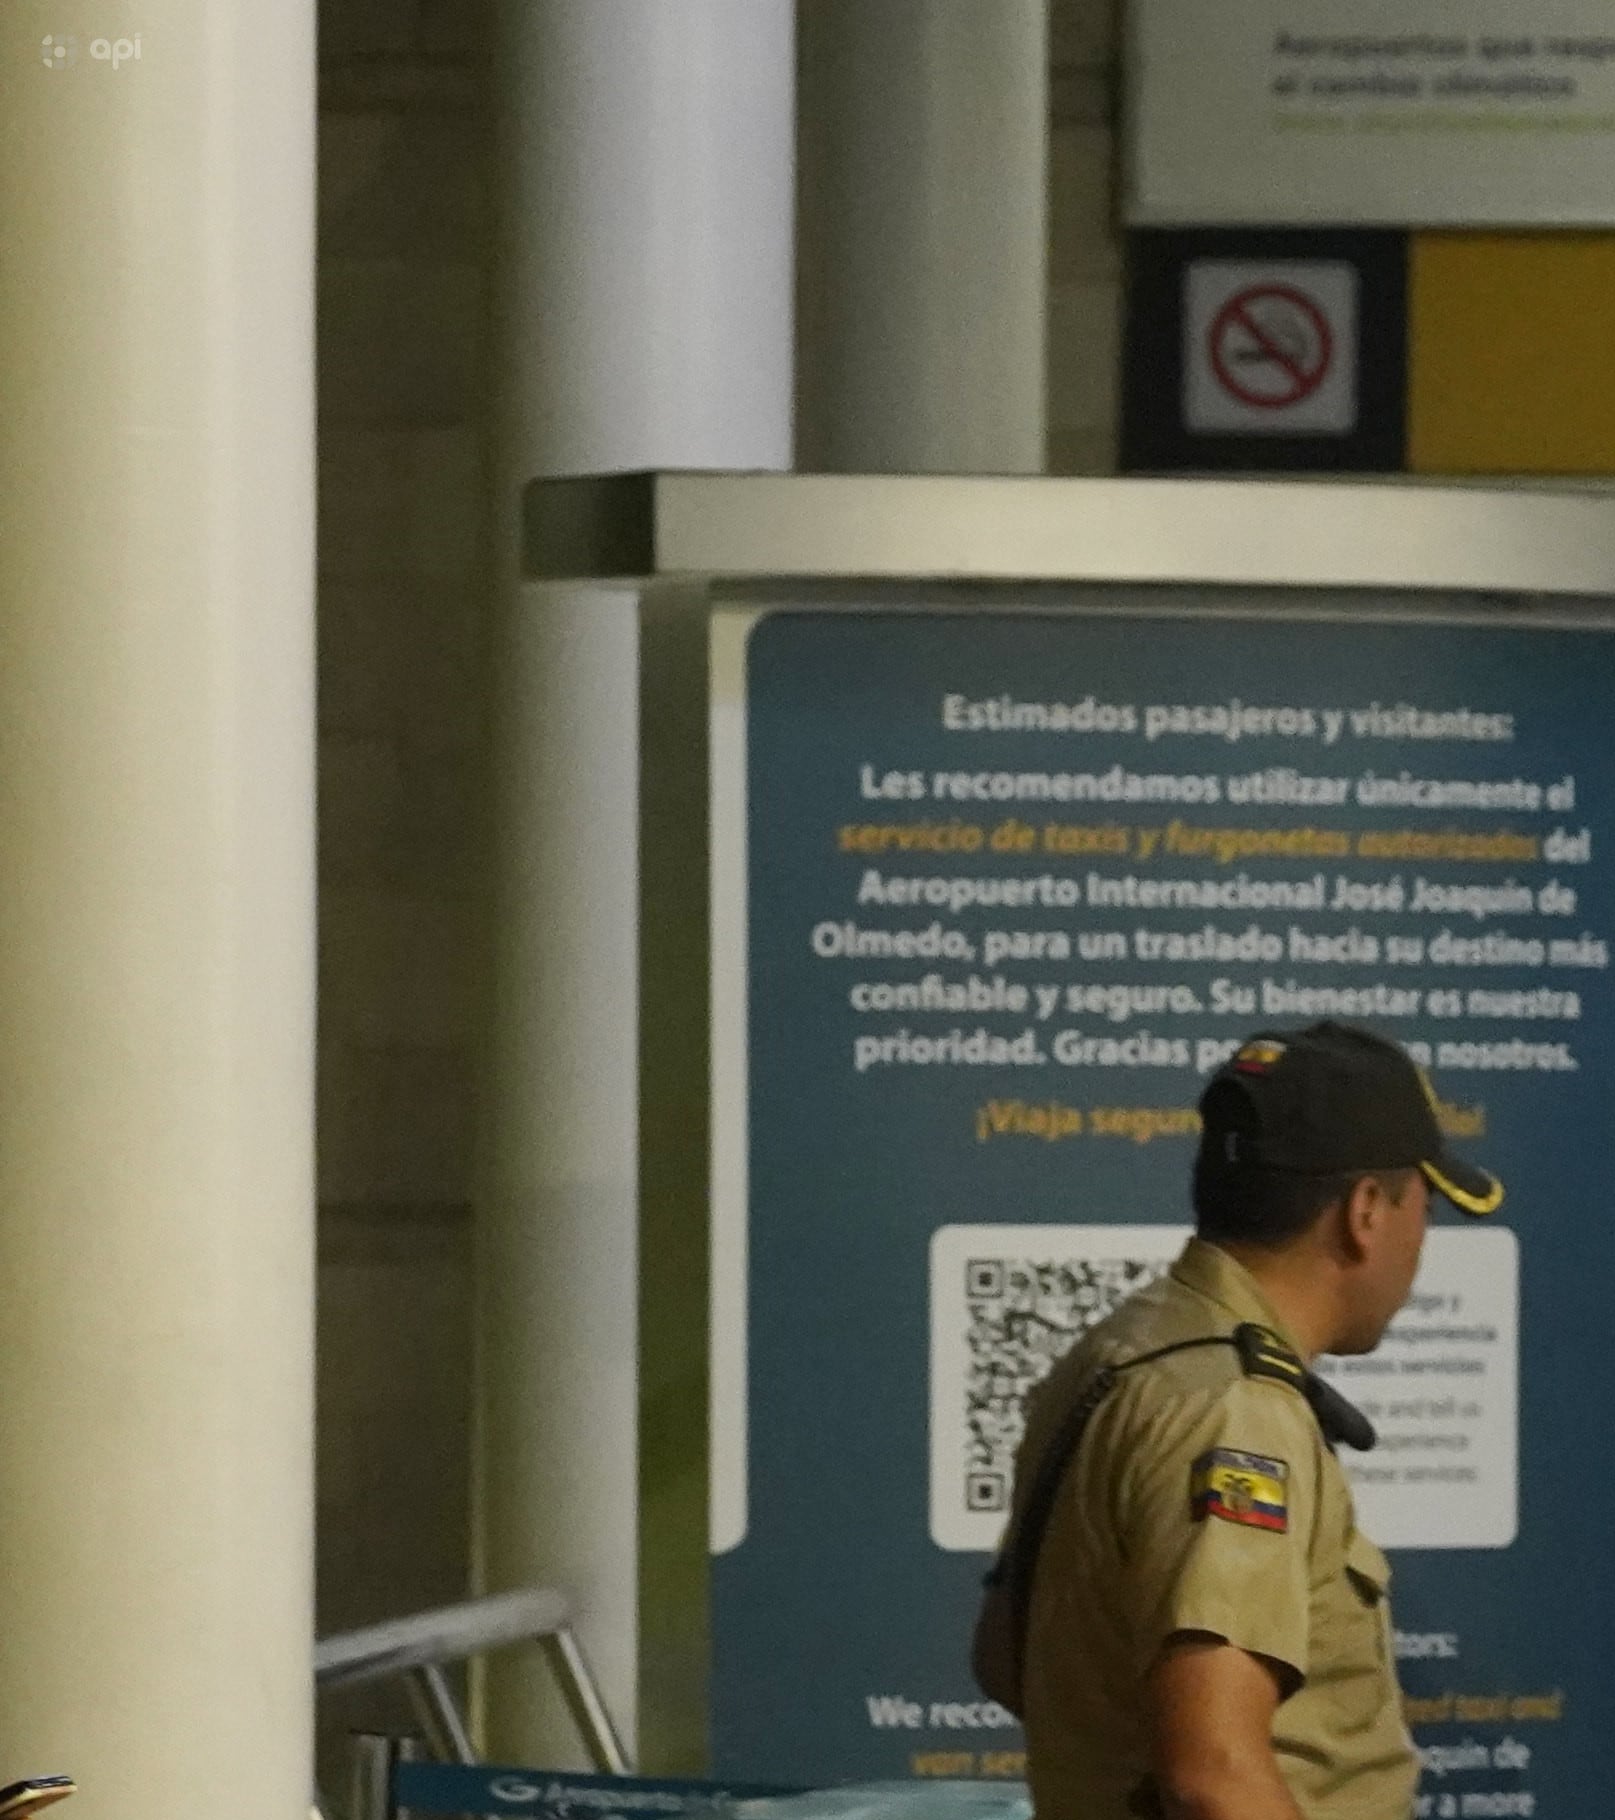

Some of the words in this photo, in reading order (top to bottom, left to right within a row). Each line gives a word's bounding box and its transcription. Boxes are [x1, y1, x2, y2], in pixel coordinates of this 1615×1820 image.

[943, 695, 1136, 731] Estimados
[1145, 699, 1317, 741] pasajeros
[1323, 709, 1343, 744] y
[861, 765, 926, 799] Les
[933, 766, 1220, 801] recomendamos
[1227, 767, 1349, 804] utilizar
[837, 818, 984, 852] servicio
[990, 819, 1035, 853] de
[1137, 829, 1161, 860] y
[1543, 827, 1592, 864] del
[857, 870, 1081, 912] Aeropuerto
[1086, 873, 1325, 911] Internacional
[812, 921, 975, 961] Olmedo,
[984, 930, 1070, 966] para
[1079, 931, 1127, 958] un
[1134, 925, 1283, 962] traslado
[1288, 926, 1379, 963] hacia
[850, 974, 1029, 1012] confiable
[1035, 986, 1060, 1019] y
[1066, 984, 1203, 1021] seguro.
[1209, 977, 1256, 1014] Su
[854, 1029, 1047, 1072] prioridad.
[1053, 1029, 1190, 1066] Gracias
[1196, 1040, 1240, 1073] po
[1088, 1107, 1203, 1143] segur
[866, 1694, 924, 1729] We
[930, 1700, 1022, 1729] reco
